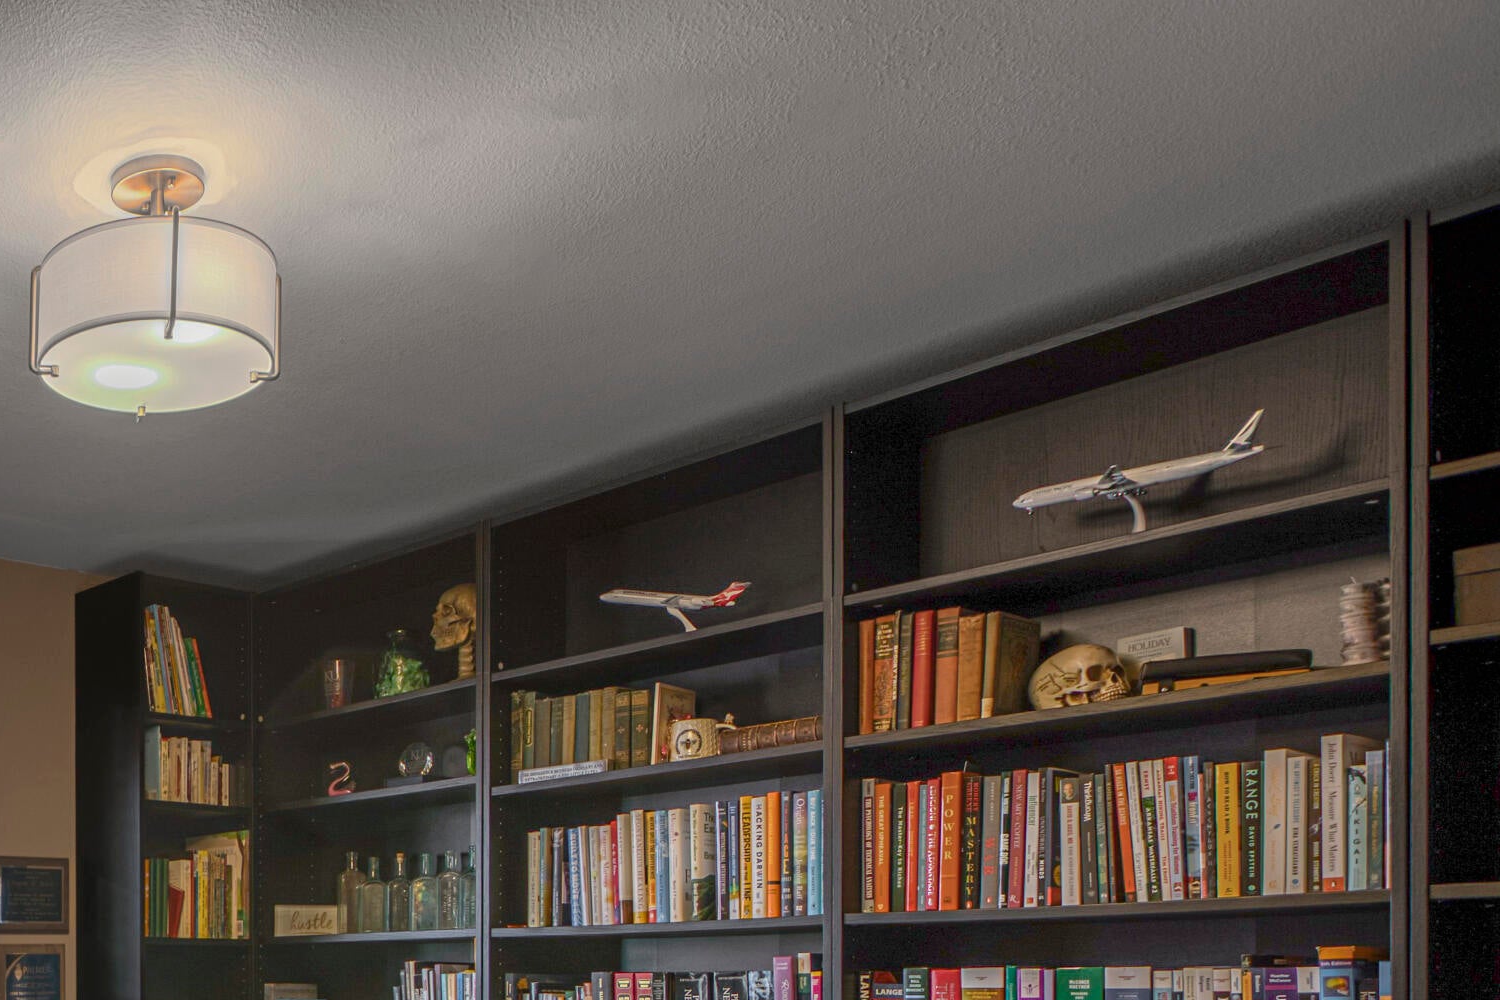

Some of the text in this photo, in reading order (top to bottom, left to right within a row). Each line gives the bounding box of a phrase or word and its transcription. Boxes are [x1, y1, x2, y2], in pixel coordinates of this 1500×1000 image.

[1128, 637, 1172, 652] HOLIDAY
[796, 798, 804, 825] Origin
[1028, 795, 1038, 826] Influencer
[1246, 769, 1258, 878] RANGE DAVID EPSTEIN
[1328, 743, 1338, 872] John Doerr Measure What Matters
[742, 812, 750, 862] LEADERSHIP
[944, 794, 954, 860] POWER
[1148, 845, 1156, 882] WATERFALLS
[290, 911, 333, 932] hustle
[876, 988, 902, 996] LANGE
